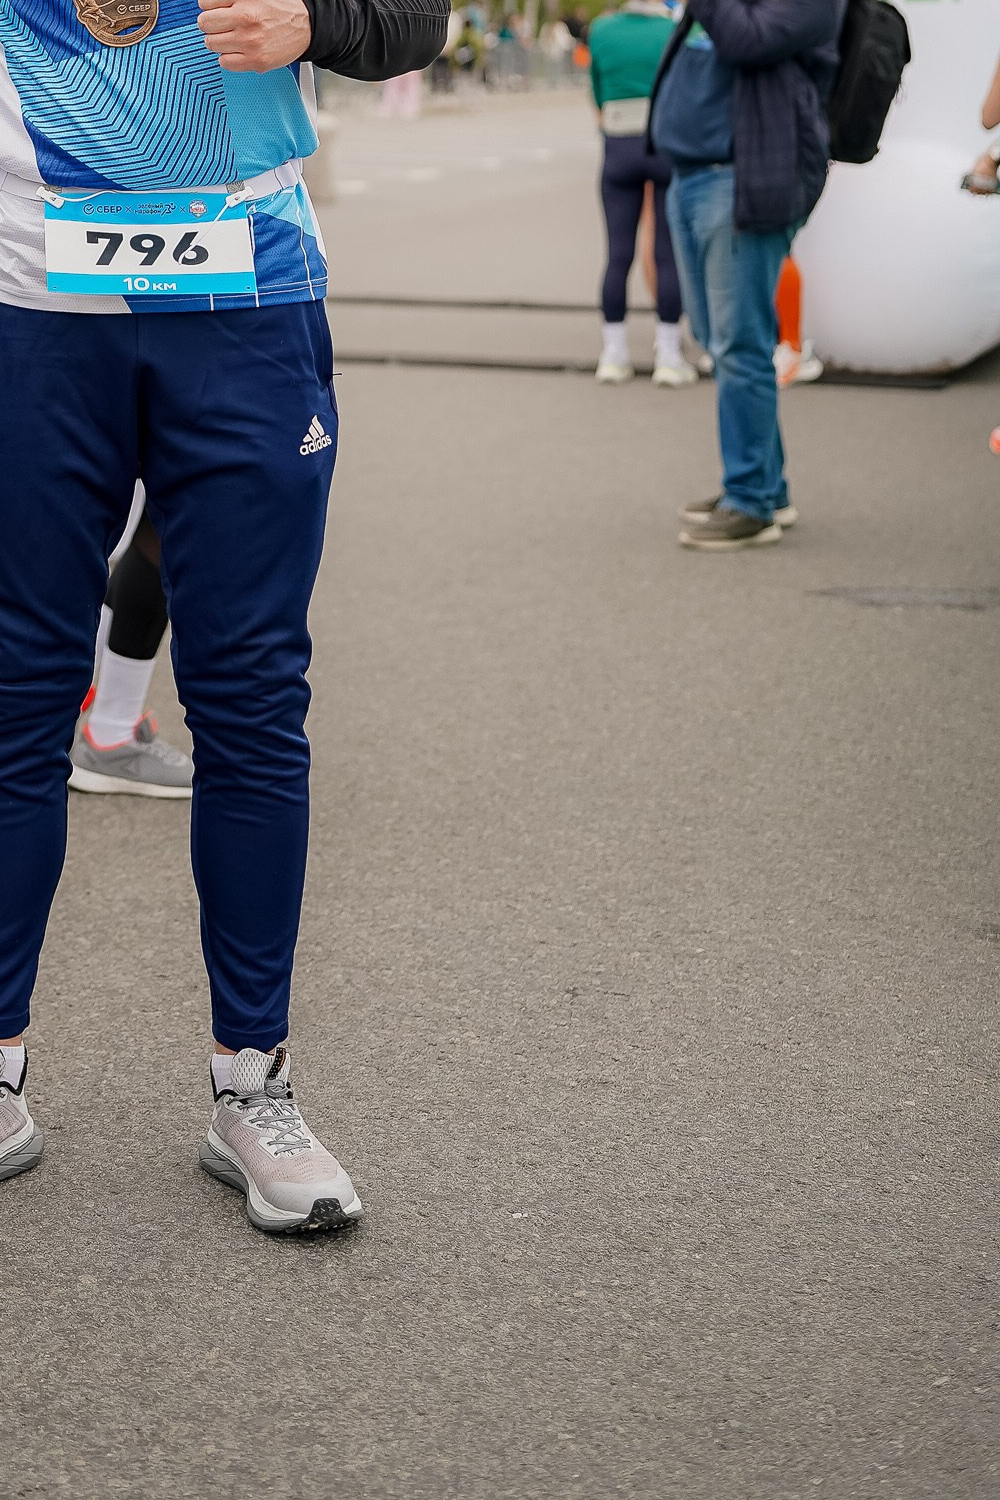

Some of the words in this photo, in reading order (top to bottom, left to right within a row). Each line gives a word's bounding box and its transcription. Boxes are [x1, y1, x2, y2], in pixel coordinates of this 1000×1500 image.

[128, 4, 151, 12] СБЕР
[96, 205, 122, 214] СБЕР
[86, 231, 209, 266] 796
[123, 277, 150, 291] 10
[300, 435, 332, 455] adidas
